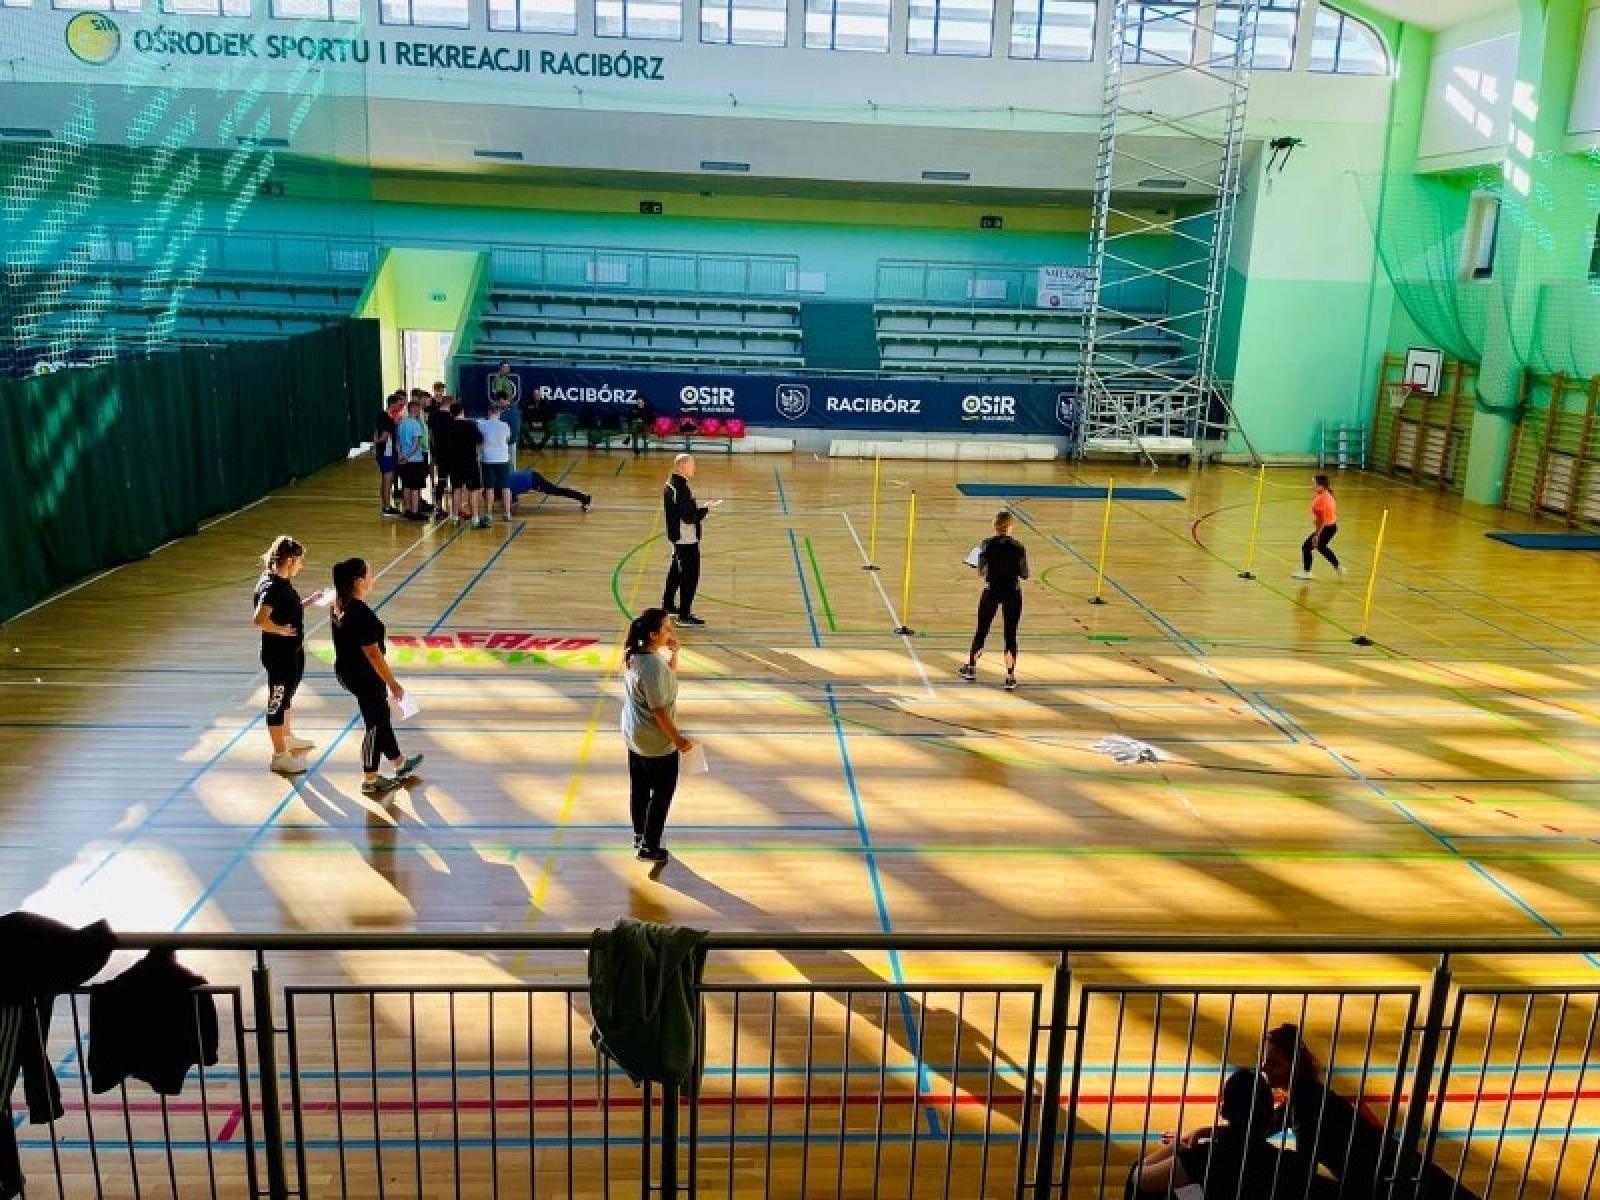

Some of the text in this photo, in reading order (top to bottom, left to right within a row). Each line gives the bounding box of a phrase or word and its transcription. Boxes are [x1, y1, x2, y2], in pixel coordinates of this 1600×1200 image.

[134, 24, 664, 80] OŚRODEK SPORTU I REKREACJI RACIBÓRZ
[539, 384, 637, 404] RACIBÓRZ
[826, 394, 921, 413] RACIBÓRZ
